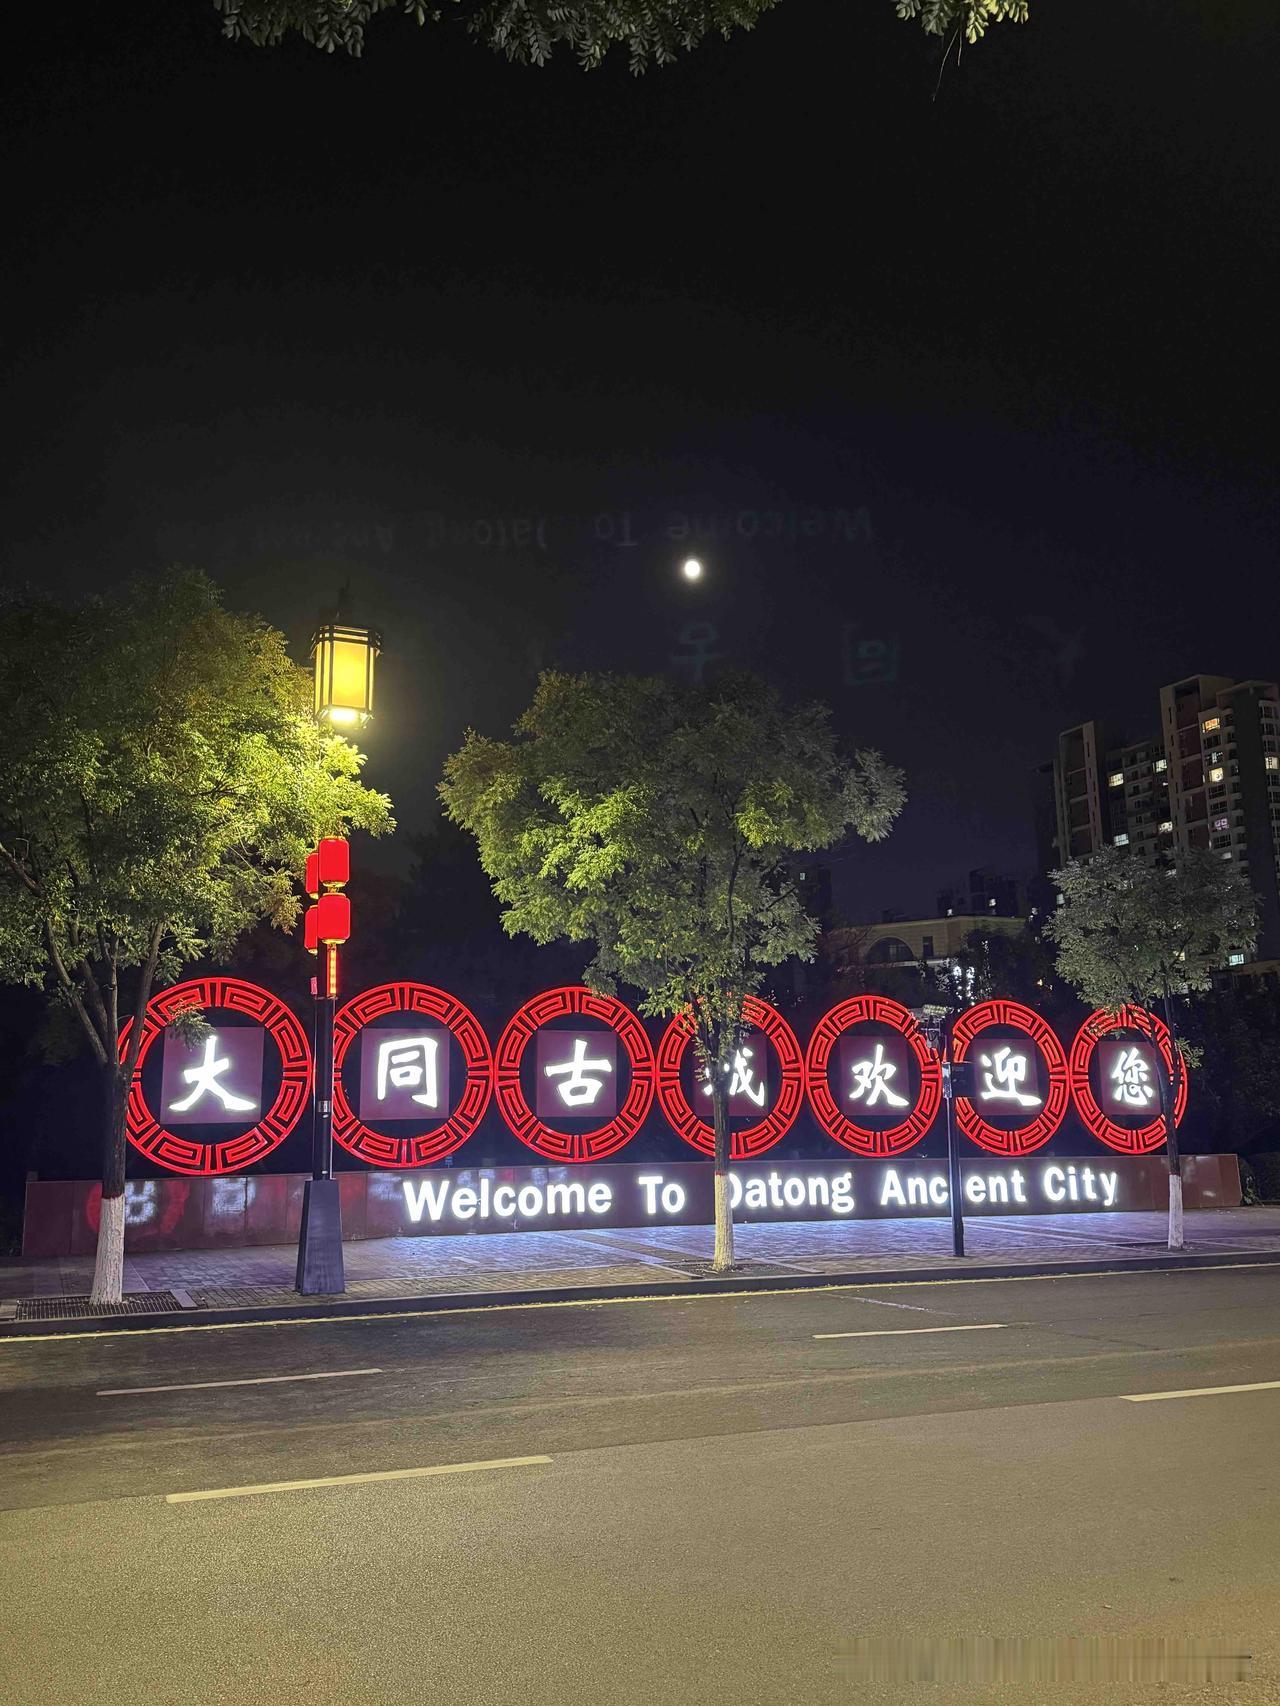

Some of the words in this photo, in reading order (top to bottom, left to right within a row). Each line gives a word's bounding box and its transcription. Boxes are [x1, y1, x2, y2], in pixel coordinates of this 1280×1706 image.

[402, 1179, 613, 1225] Welcome
[637, 1175, 686, 1216] To
[879, 1168, 1028, 1207] Ancent
[1042, 1165, 1119, 1208] City
